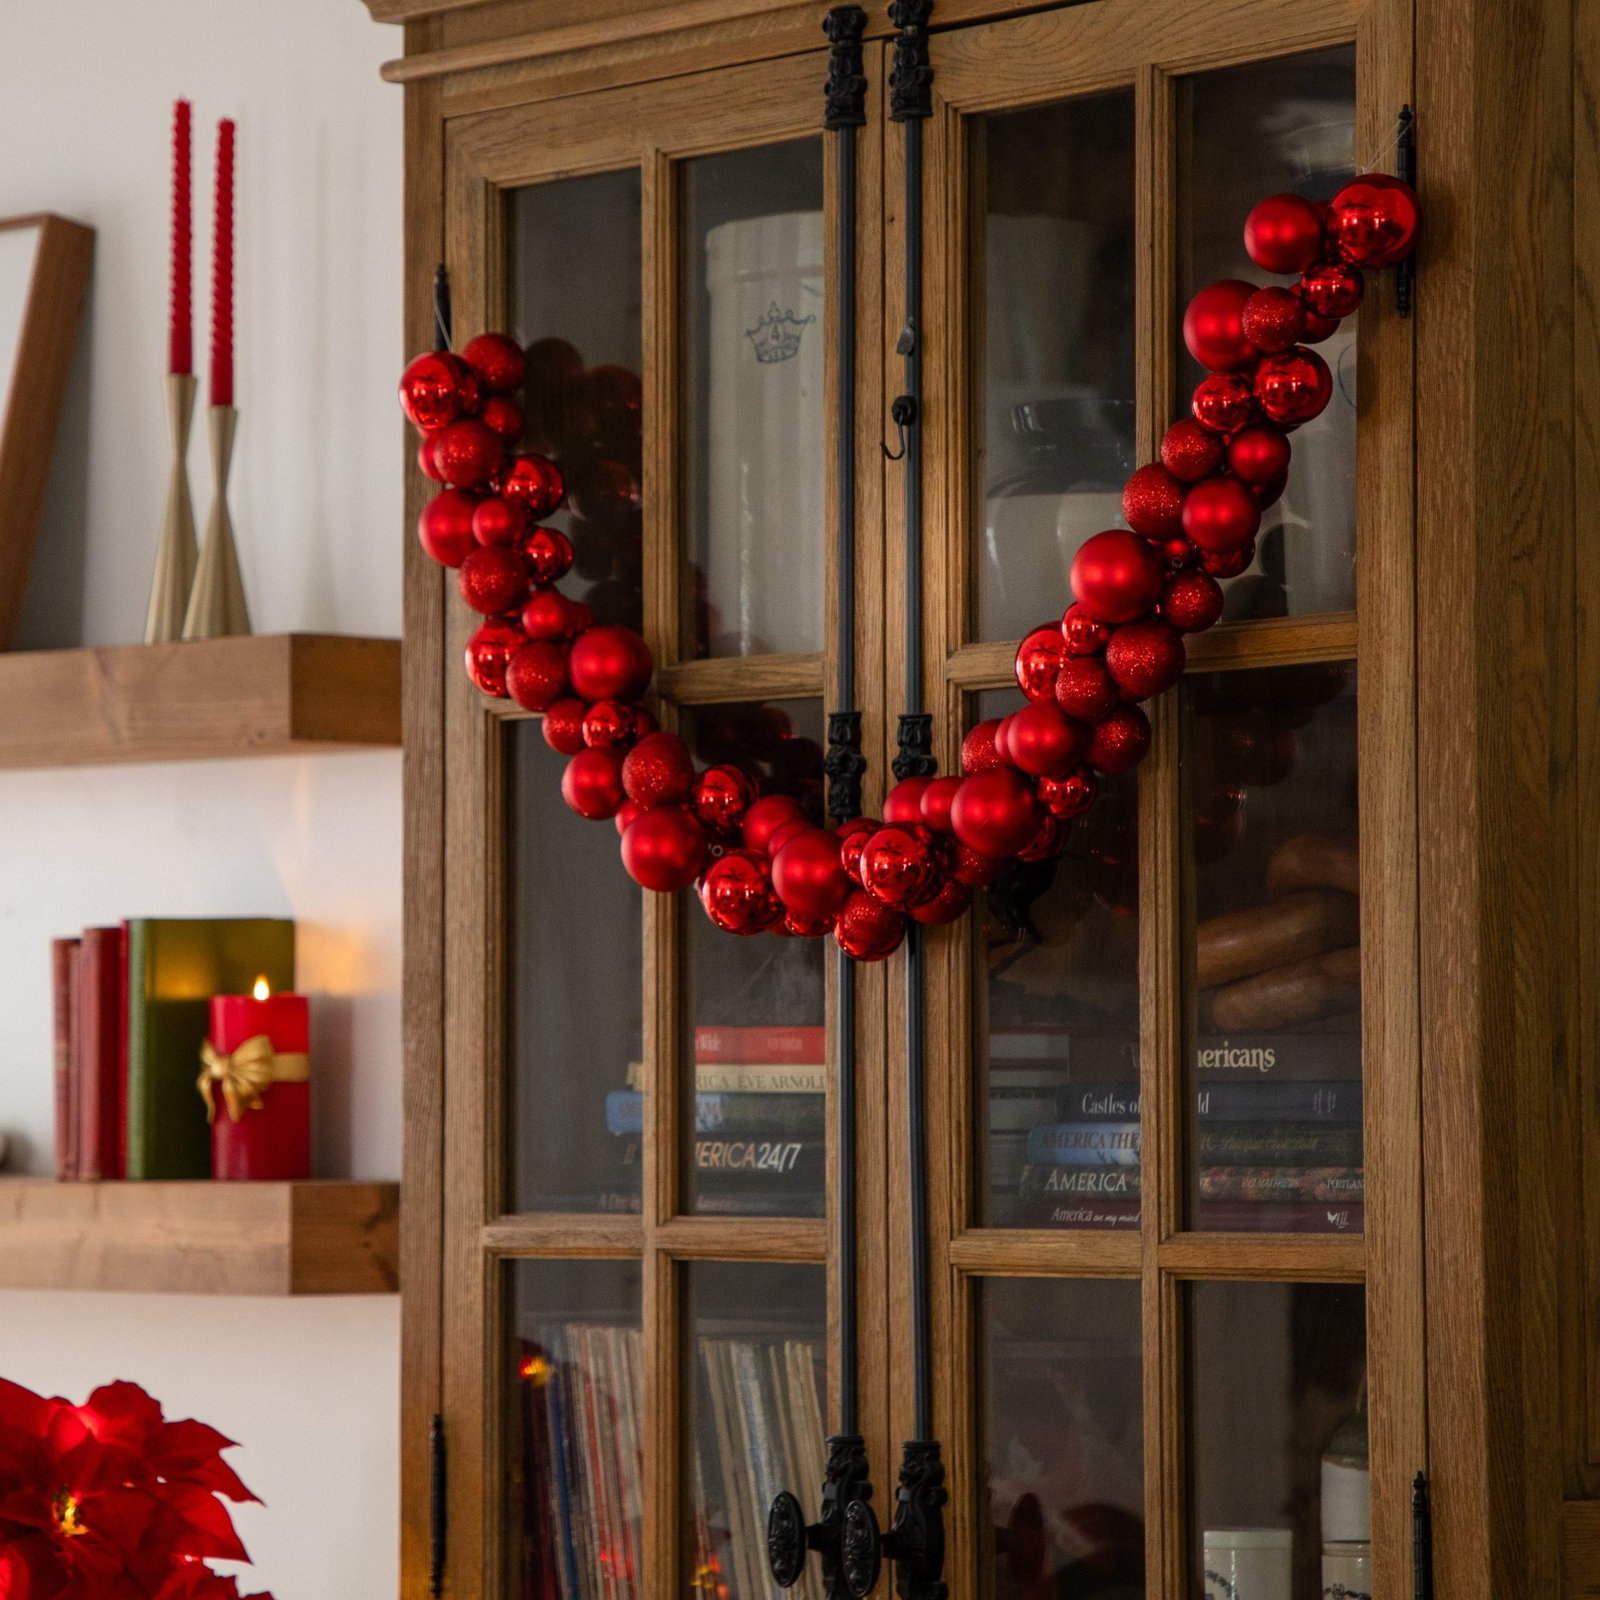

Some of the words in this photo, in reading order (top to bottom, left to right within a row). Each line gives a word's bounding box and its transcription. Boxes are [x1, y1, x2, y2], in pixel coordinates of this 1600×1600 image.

[738, 1074, 767, 1089] EVE
[1082, 1092, 1126, 1114] Castles
[1042, 1132, 1107, 1149] AMERICA
[1044, 1169, 1129, 1191] AMERICA
[1051, 1207, 1094, 1222] America
[1105, 1215, 1118, 1227] my
[1119, 1211, 1140, 1222] mind
